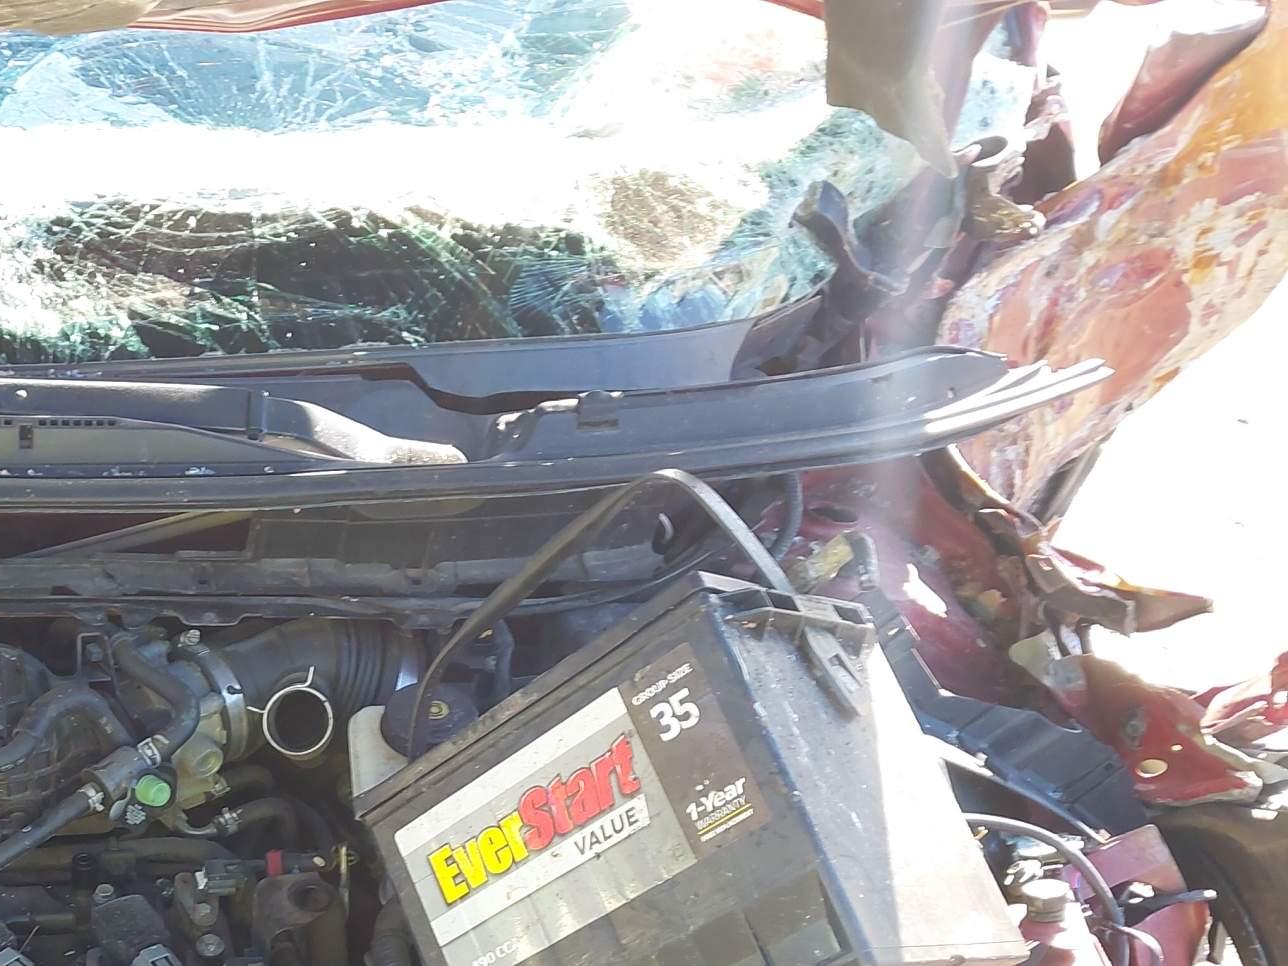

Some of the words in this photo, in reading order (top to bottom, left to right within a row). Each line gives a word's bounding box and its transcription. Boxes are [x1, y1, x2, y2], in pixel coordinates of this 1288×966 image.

[649, 688, 700, 742] 35
[428, 733, 641, 905] EverStart
[686, 777, 746, 821] 1-Year
[574, 806, 640, 856] VALUE
